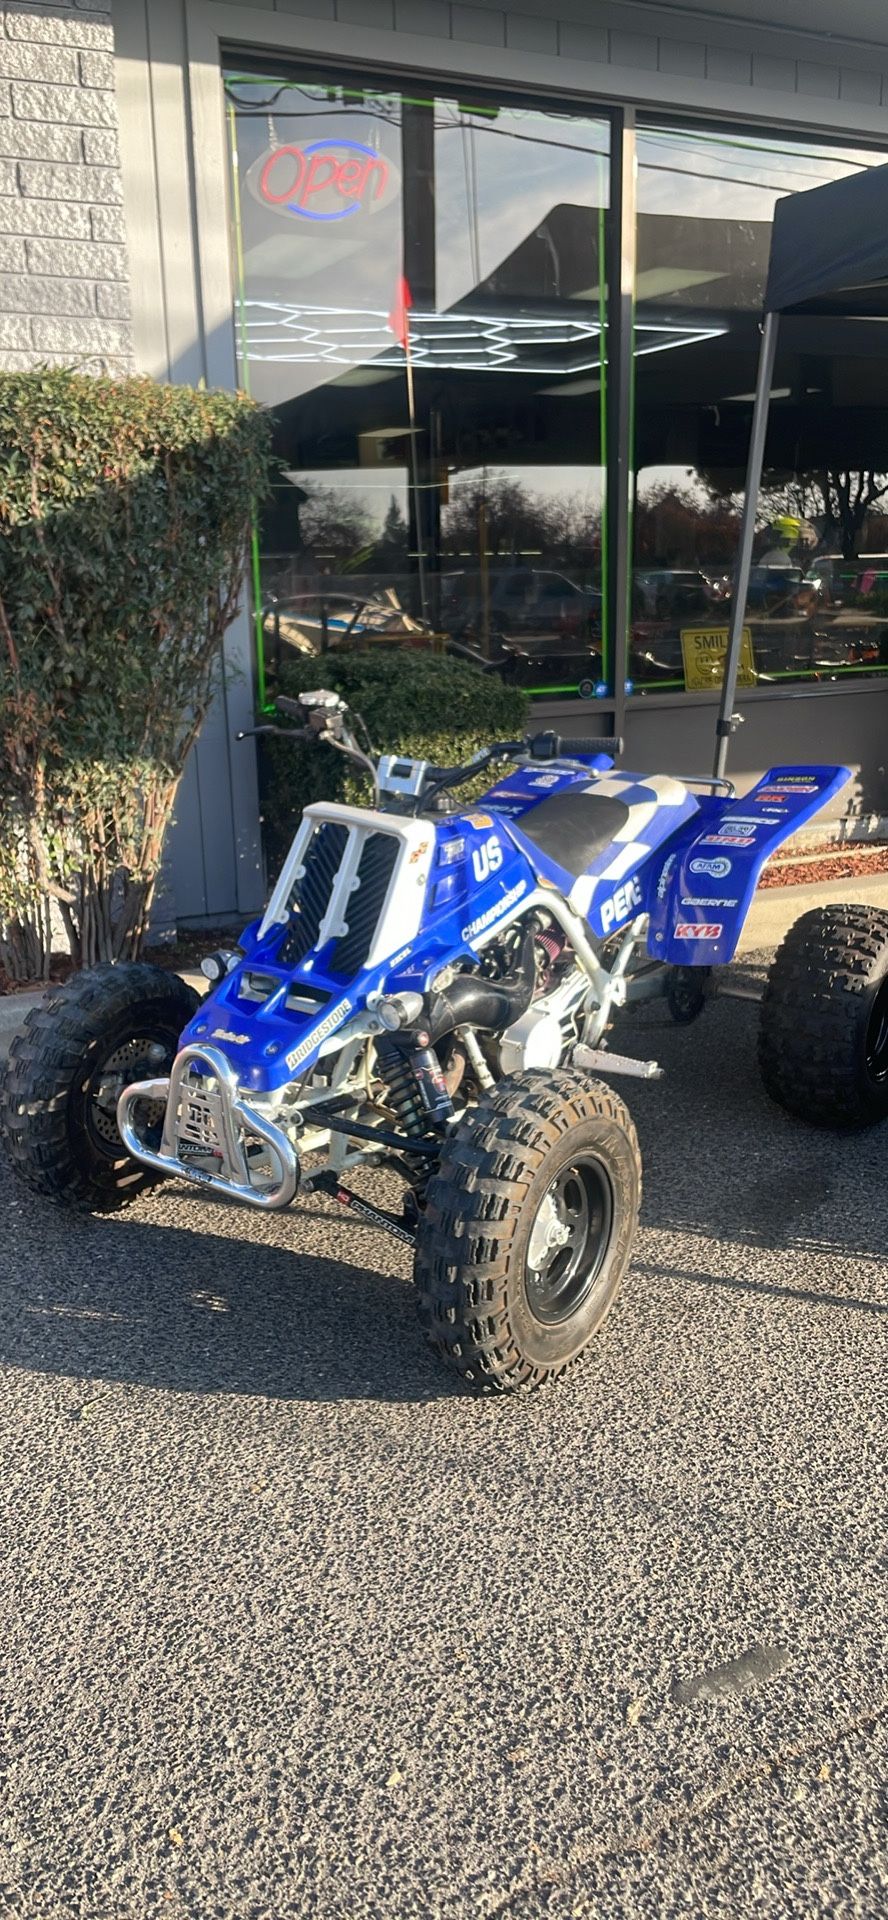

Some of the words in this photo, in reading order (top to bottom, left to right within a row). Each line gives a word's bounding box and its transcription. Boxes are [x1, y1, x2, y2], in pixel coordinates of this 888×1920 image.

[260, 146, 389, 208] Open
[694, 634, 729, 650] SMIL
[472, 836, 503, 882] US
[461, 880, 526, 942] CHAMPIONSHIP
[675, 925, 721, 937] KYB
[287, 1000, 351, 1068] BRIDGESTONE
[350, 1200, 416, 1245] PHANTOM
